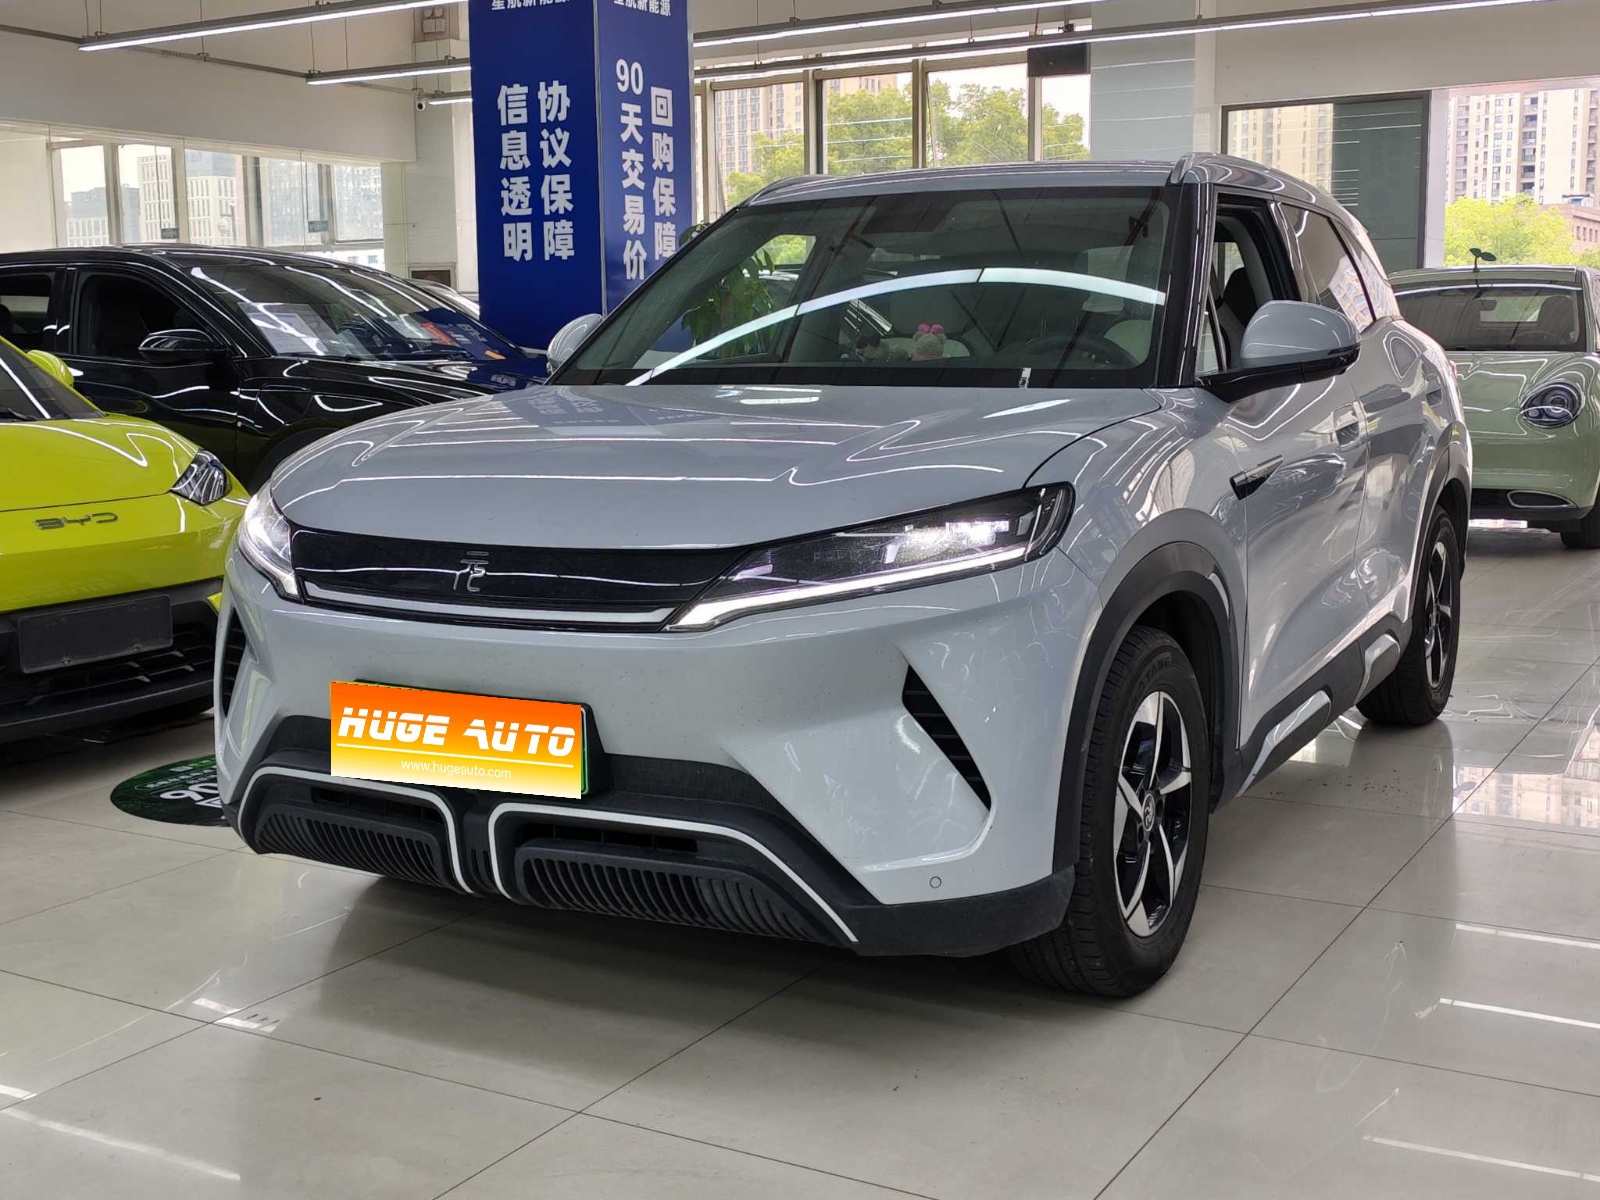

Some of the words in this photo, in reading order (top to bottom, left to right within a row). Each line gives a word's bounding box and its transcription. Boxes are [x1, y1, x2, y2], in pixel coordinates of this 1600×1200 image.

[497, 83, 533, 262] 信息透明
[537, 80, 575, 261] 协议保障
[650, 86, 677, 261] 回购保障
[34, 511, 119, 530] BYD
